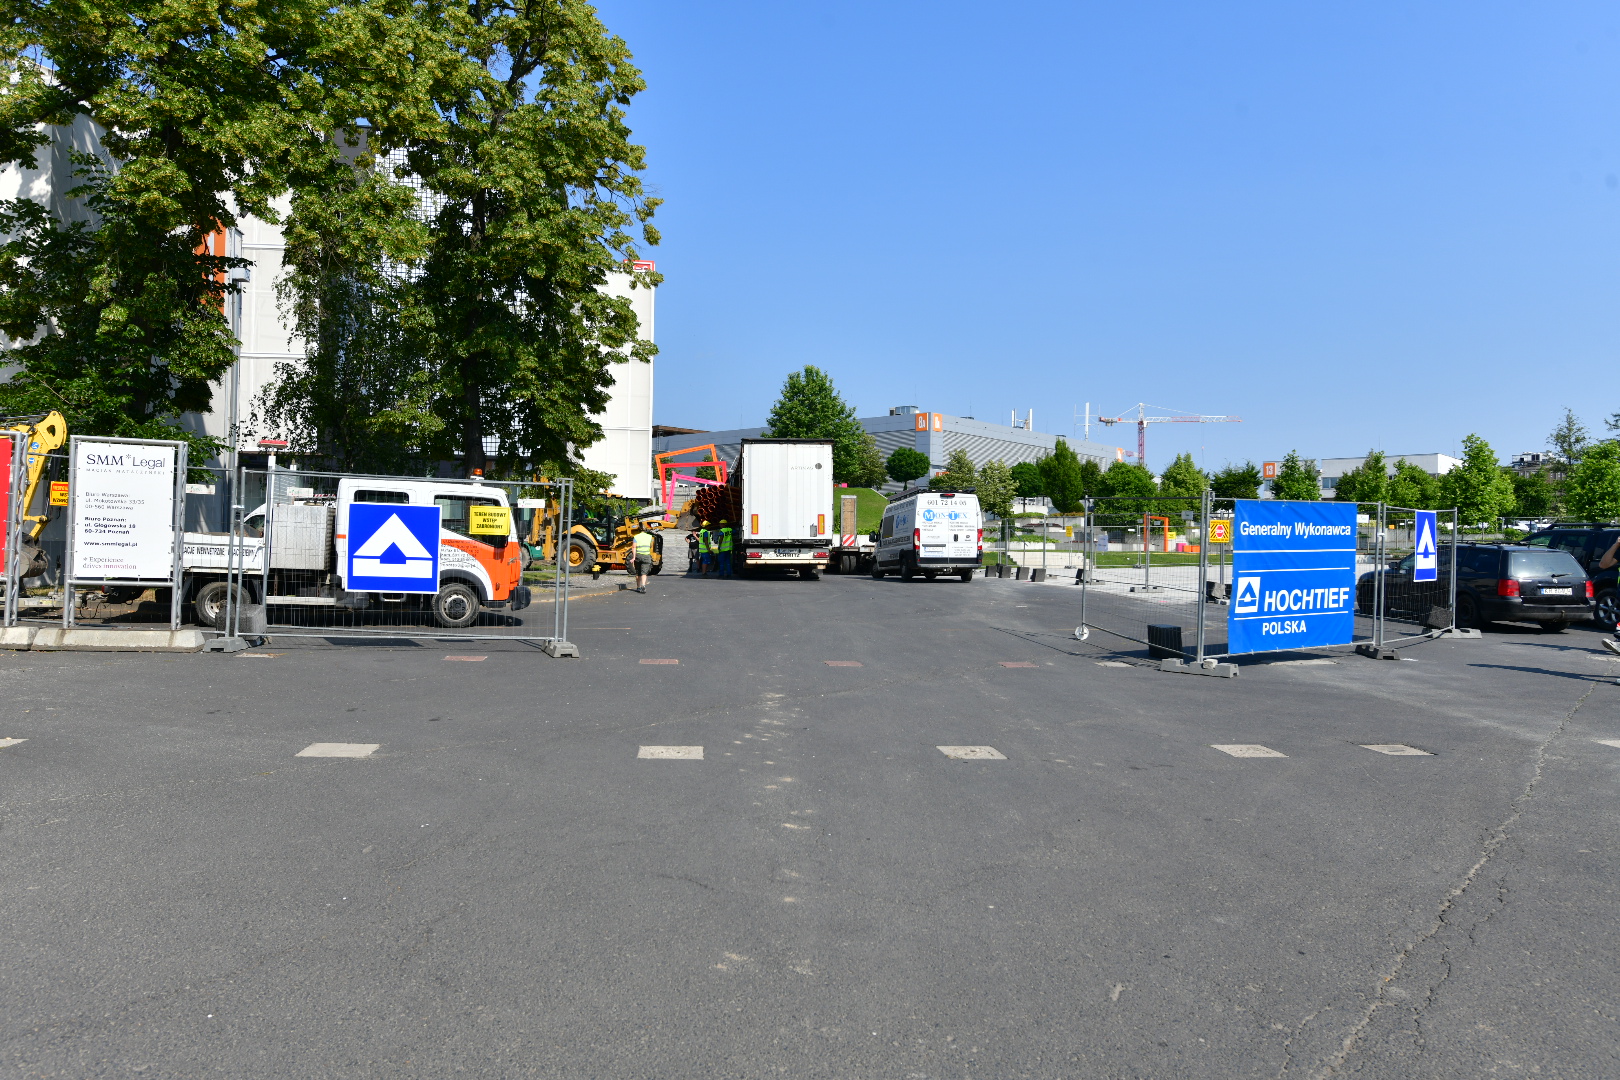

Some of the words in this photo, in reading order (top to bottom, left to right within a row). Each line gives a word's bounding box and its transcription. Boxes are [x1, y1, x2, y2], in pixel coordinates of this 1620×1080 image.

[1265, 465, 1274, 475] 13
[1240, 521, 1292, 539] Generalny
[1294, 522, 1351, 539] Wykonawca
[1263, 587, 1350, 612] HOCHTIEF
[1262, 620, 1307, 636] POLSKA
